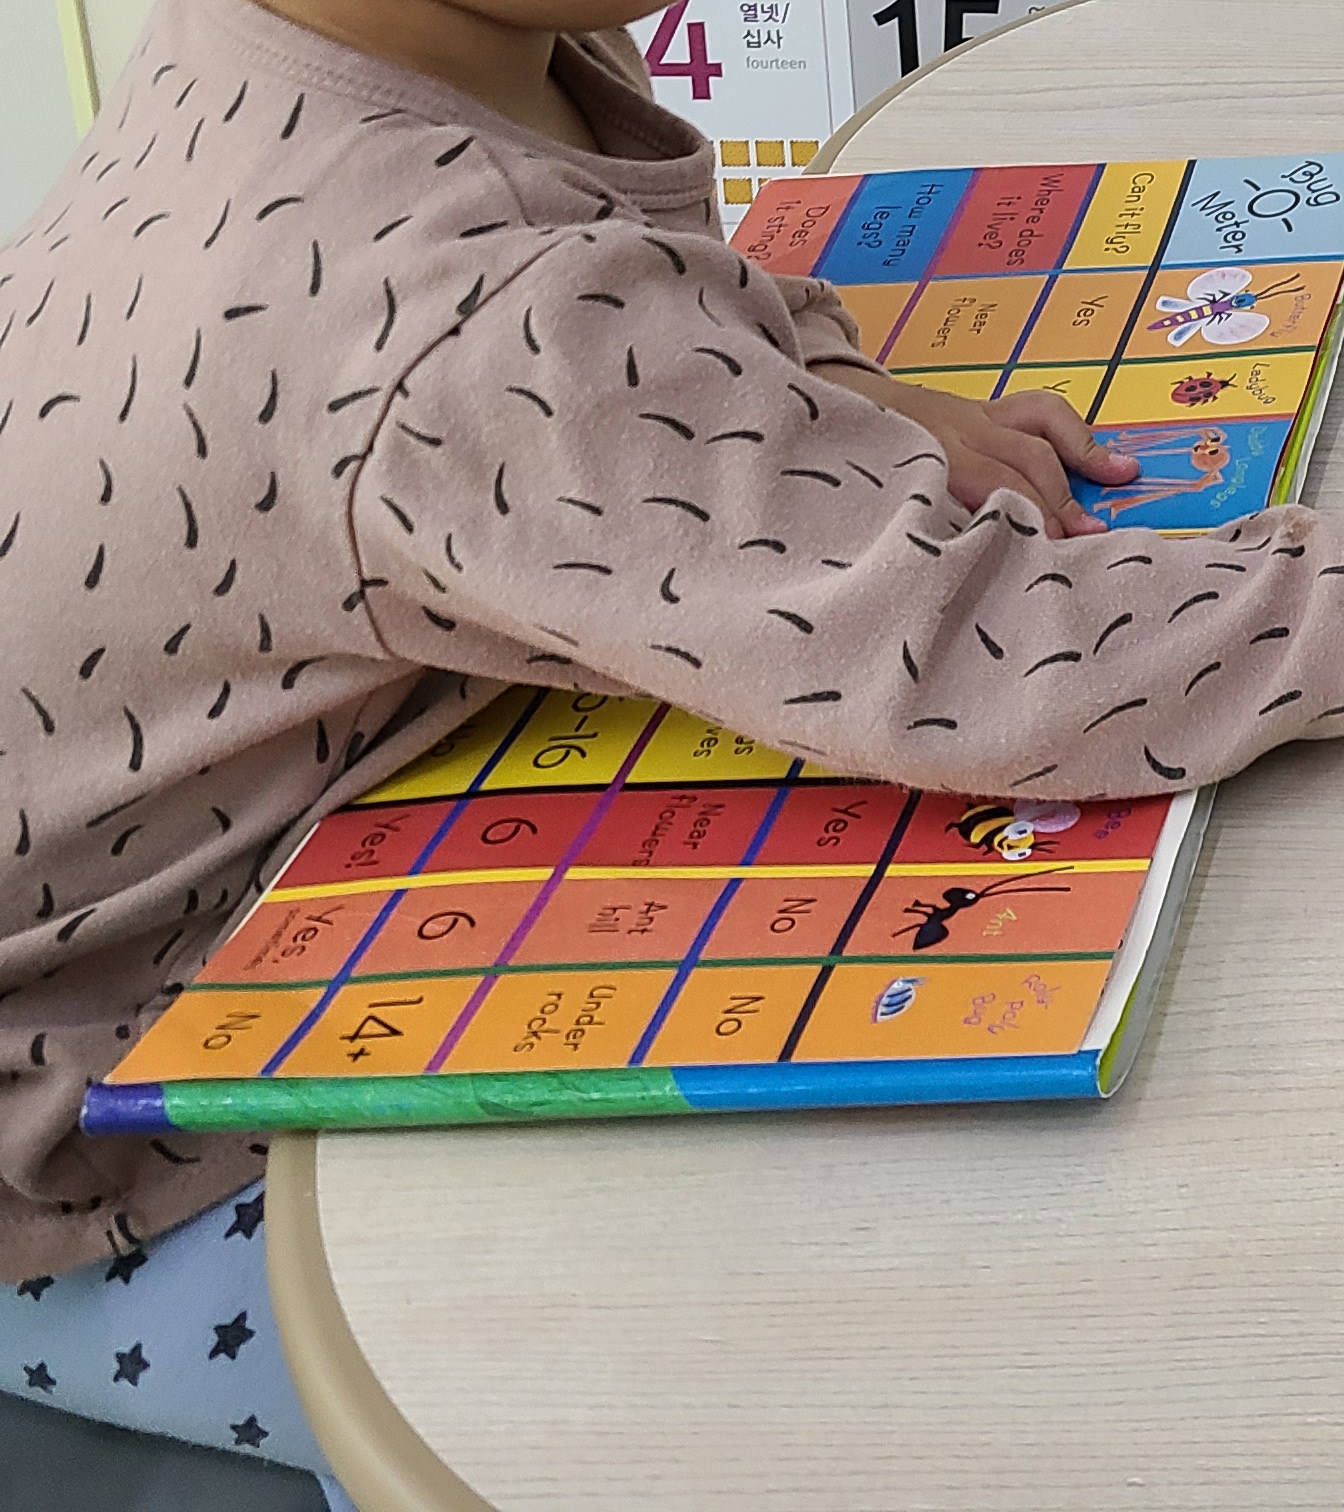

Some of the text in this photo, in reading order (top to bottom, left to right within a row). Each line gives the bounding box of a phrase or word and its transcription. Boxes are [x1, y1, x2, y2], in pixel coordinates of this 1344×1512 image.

[739, 2, 792, 26] 열넷/
[742, 29, 784, 50] 십사
[745, 55, 807, 71] fourteen
[1281, 160, 1341, 207] Bug
[789, 204, 831, 248] Does
[857, 205, 902, 249] legs?
[882, 184, 944, 267] How many
[977, 196, 1022, 250] it live?
[1006, 173, 1065, 267] Where does
[1104, 172, 1155, 255] Can it fly?
[1191, 191, 1250, 255] Meter
[931, 297, 976, 349] flowers
[969, 303, 998, 335] Near
[1072, 295, 1109, 327] Yes
[1246, 362, 1277, 405] Ladybug
[344, 813, 411, 870] Yes!
[480, 817, 539, 846] 6
[681, 802, 726, 850] Near
[816, 799, 869, 849] Yes
[417, 911, 477, 940] 6
[588, 904, 632, 934] hill
[627, 901, 668, 936] Ant
[770, 896, 819, 935] No
[982, 908, 1017, 938] Ant
[203, 1011, 261, 1050] No
[339, 996, 423, 1062] 14+
[513, 990, 564, 1054] rocks
[563, 984, 617, 1053] Under
[715, 994, 765, 1037] No
